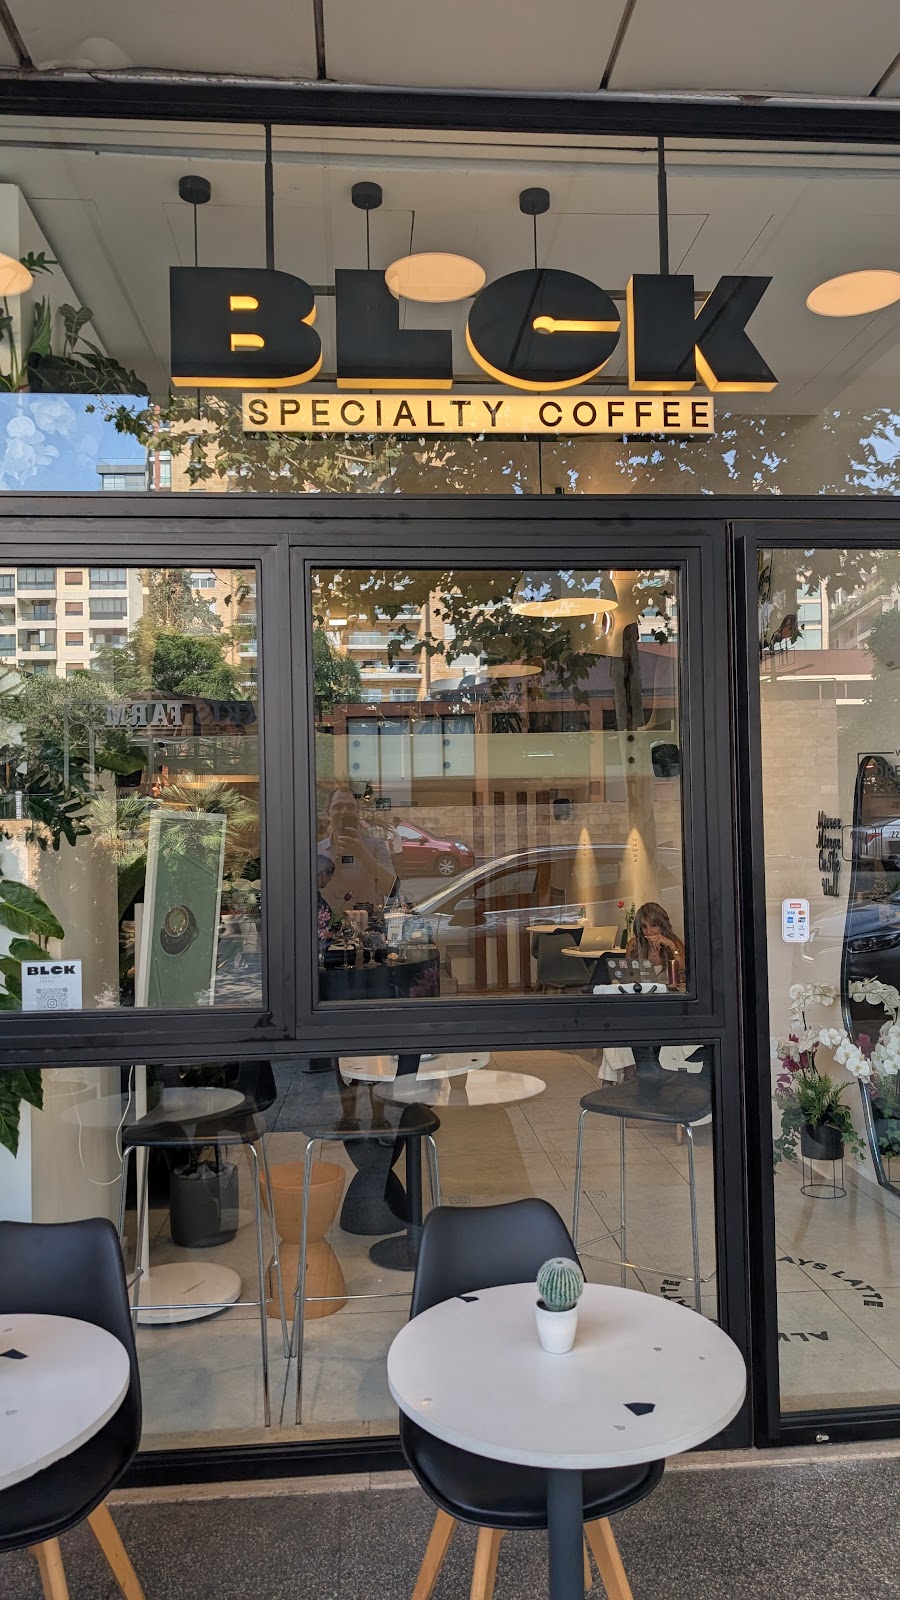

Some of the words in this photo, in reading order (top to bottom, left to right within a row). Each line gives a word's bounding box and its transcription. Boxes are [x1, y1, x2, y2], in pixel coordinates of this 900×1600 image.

[169, 266, 779, 393] BLCK
[249, 398, 504, 427] SPECIALTY
[538, 400, 709, 428] COFFEE
[27, 965, 76, 976] BLCK
[830, 1270, 883, 1308] LATTE
